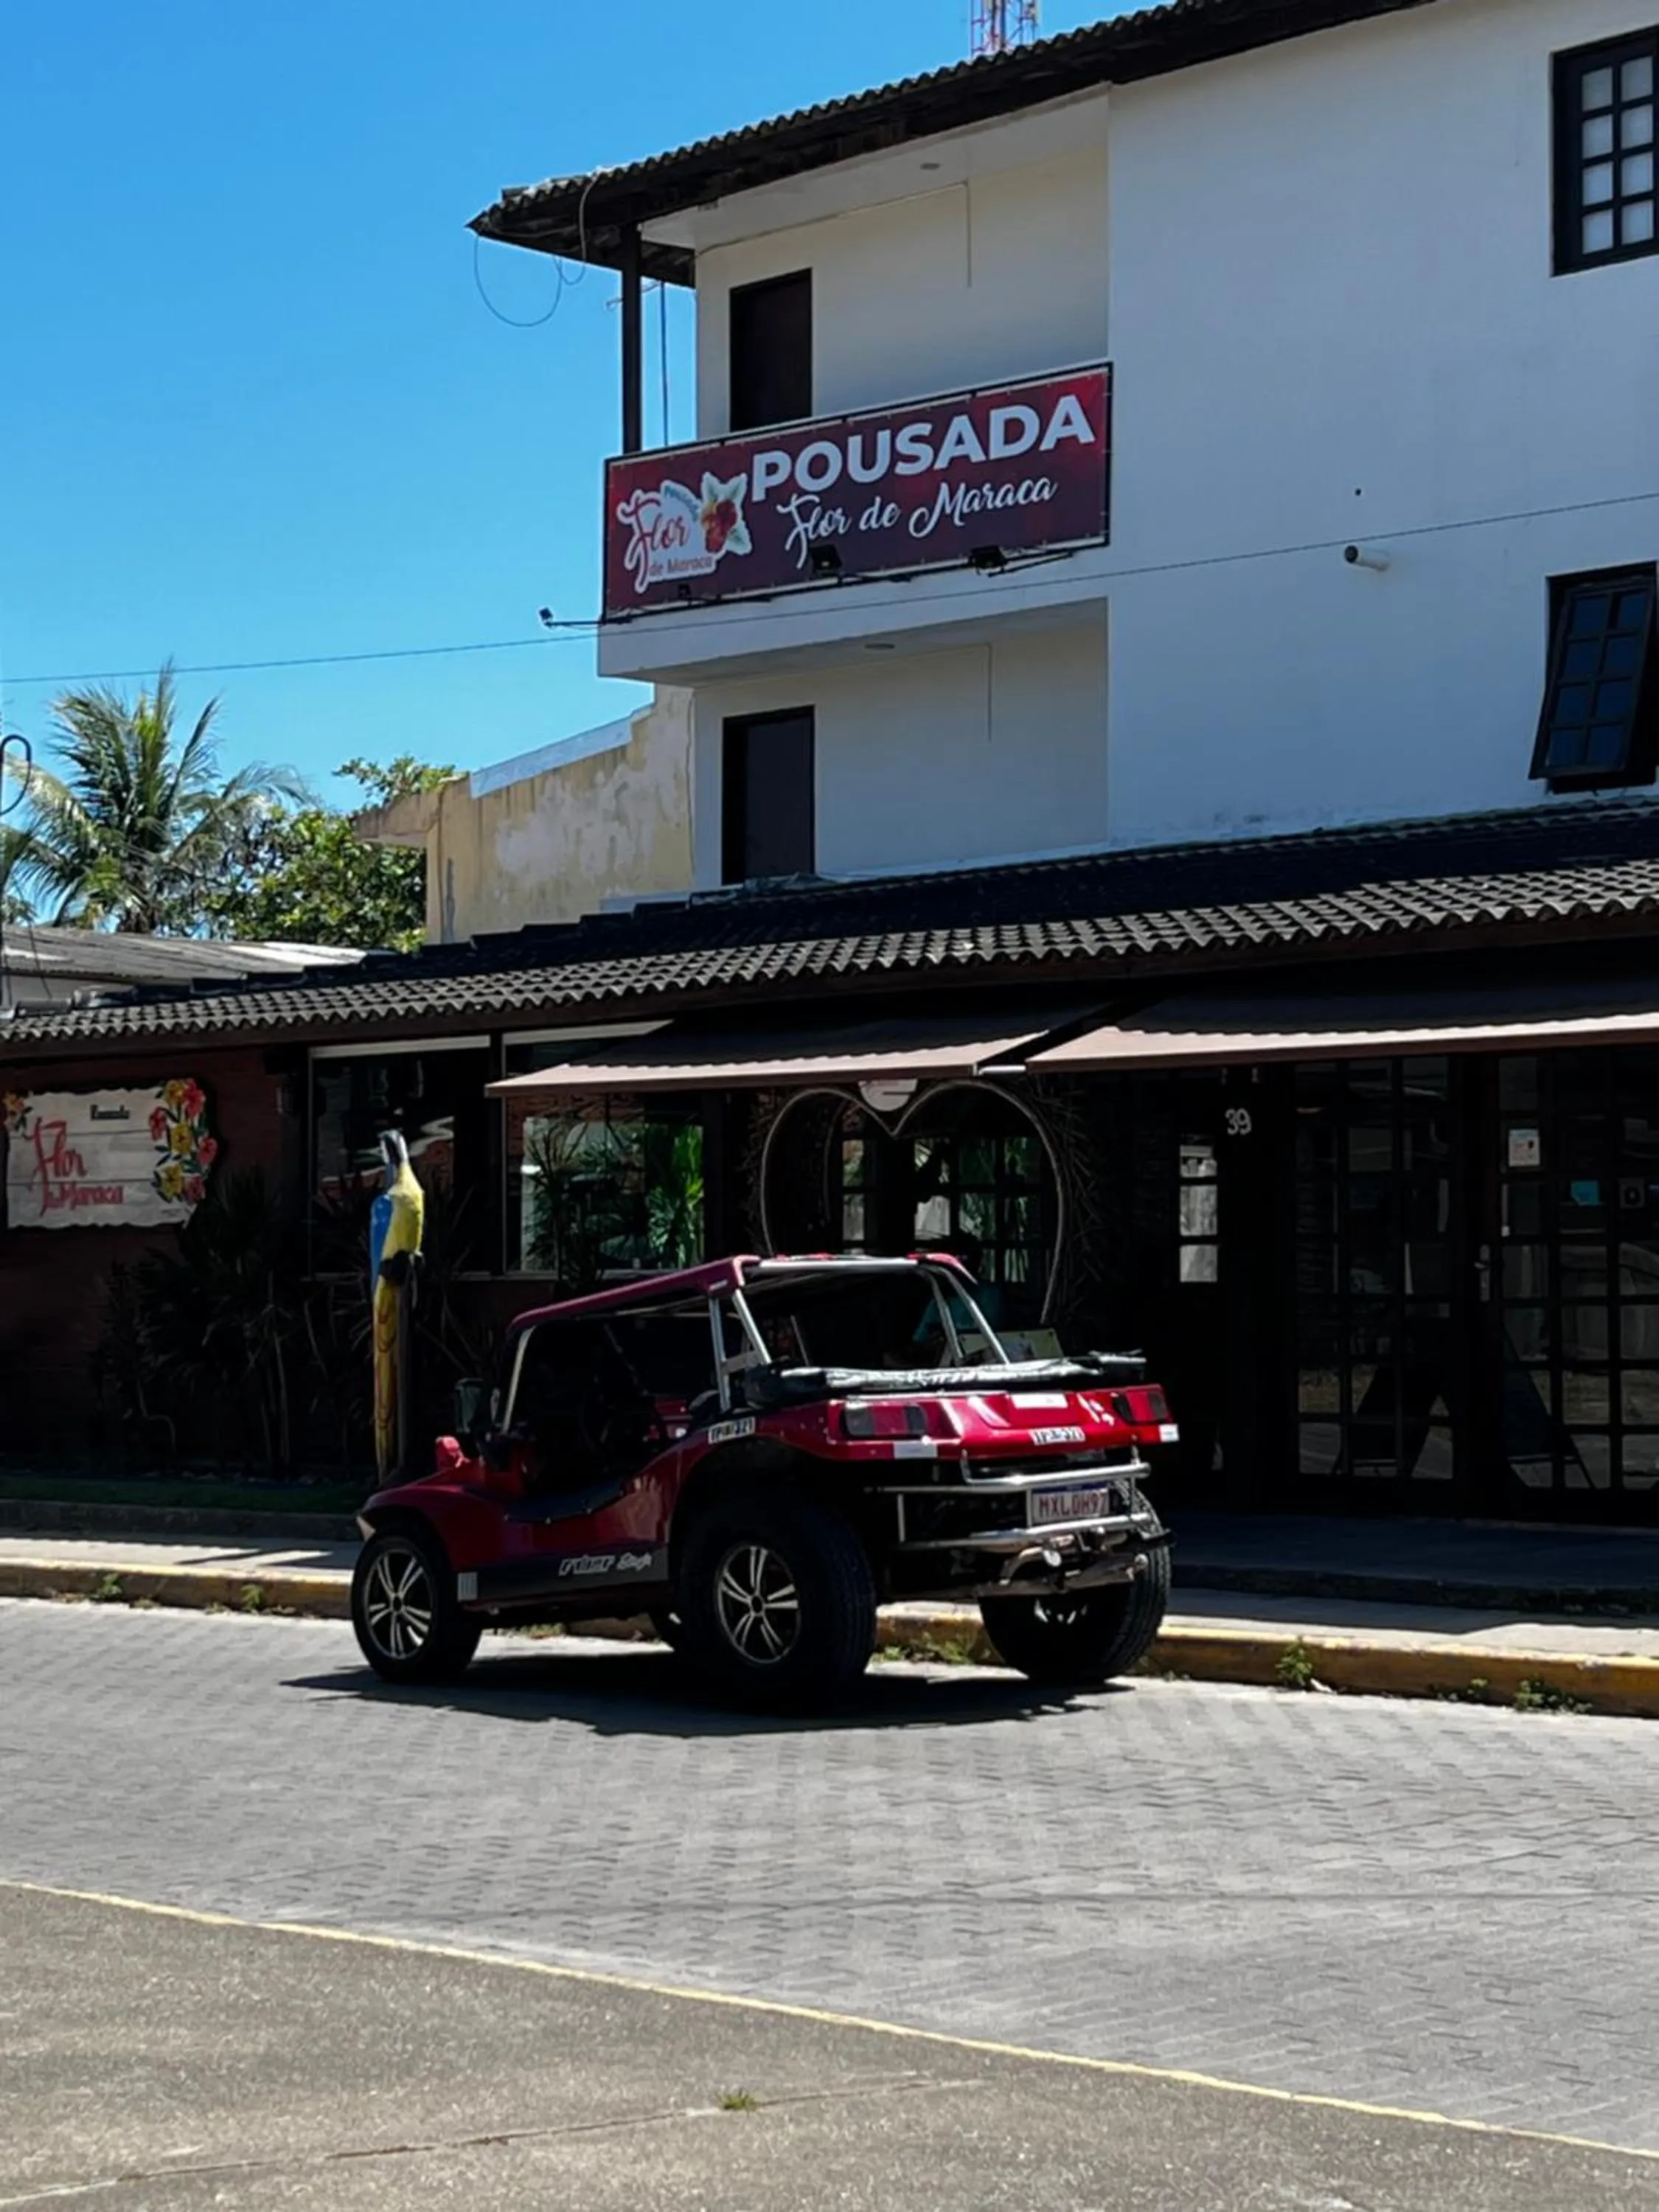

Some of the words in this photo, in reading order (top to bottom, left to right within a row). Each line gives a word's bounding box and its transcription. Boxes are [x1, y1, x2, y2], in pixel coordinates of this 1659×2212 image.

[751, 394, 1096, 502] POUSADA
[621, 494, 686, 588] Flor
[776, 493, 852, 570] Flor
[858, 495, 901, 532] de
[908, 476, 1058, 538] Maraca
[21, 1116, 88, 1217] Flor
[1225, 1107, 1251, 1135] 39
